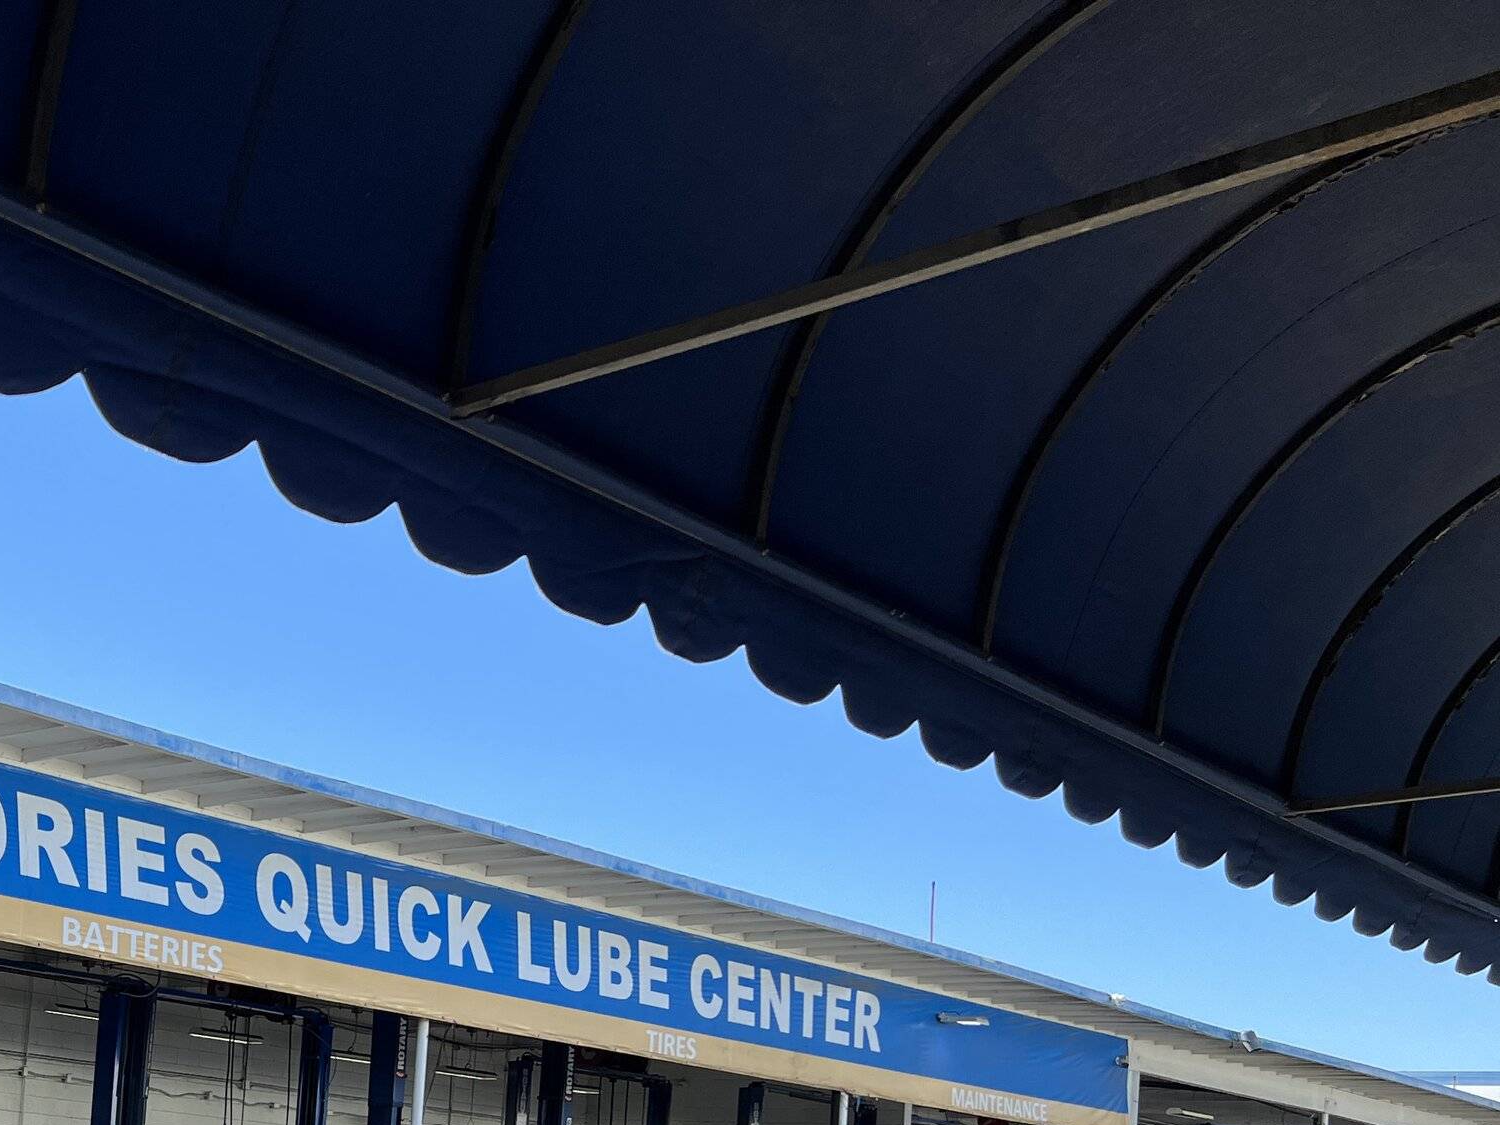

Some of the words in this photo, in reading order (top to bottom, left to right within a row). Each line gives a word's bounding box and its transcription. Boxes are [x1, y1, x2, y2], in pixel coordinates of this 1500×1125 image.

[62, 916, 224, 974] BATTERIES
[256, 853, 494, 973] QUICK
[517, 910, 670, 1010] LUBE
[690, 953, 881, 1053] CENTER
[397, 1016, 407, 1070] ROTARY
[645, 1029, 697, 1060] TIRES
[951, 1087, 1048, 1122] MAINTENANCE
